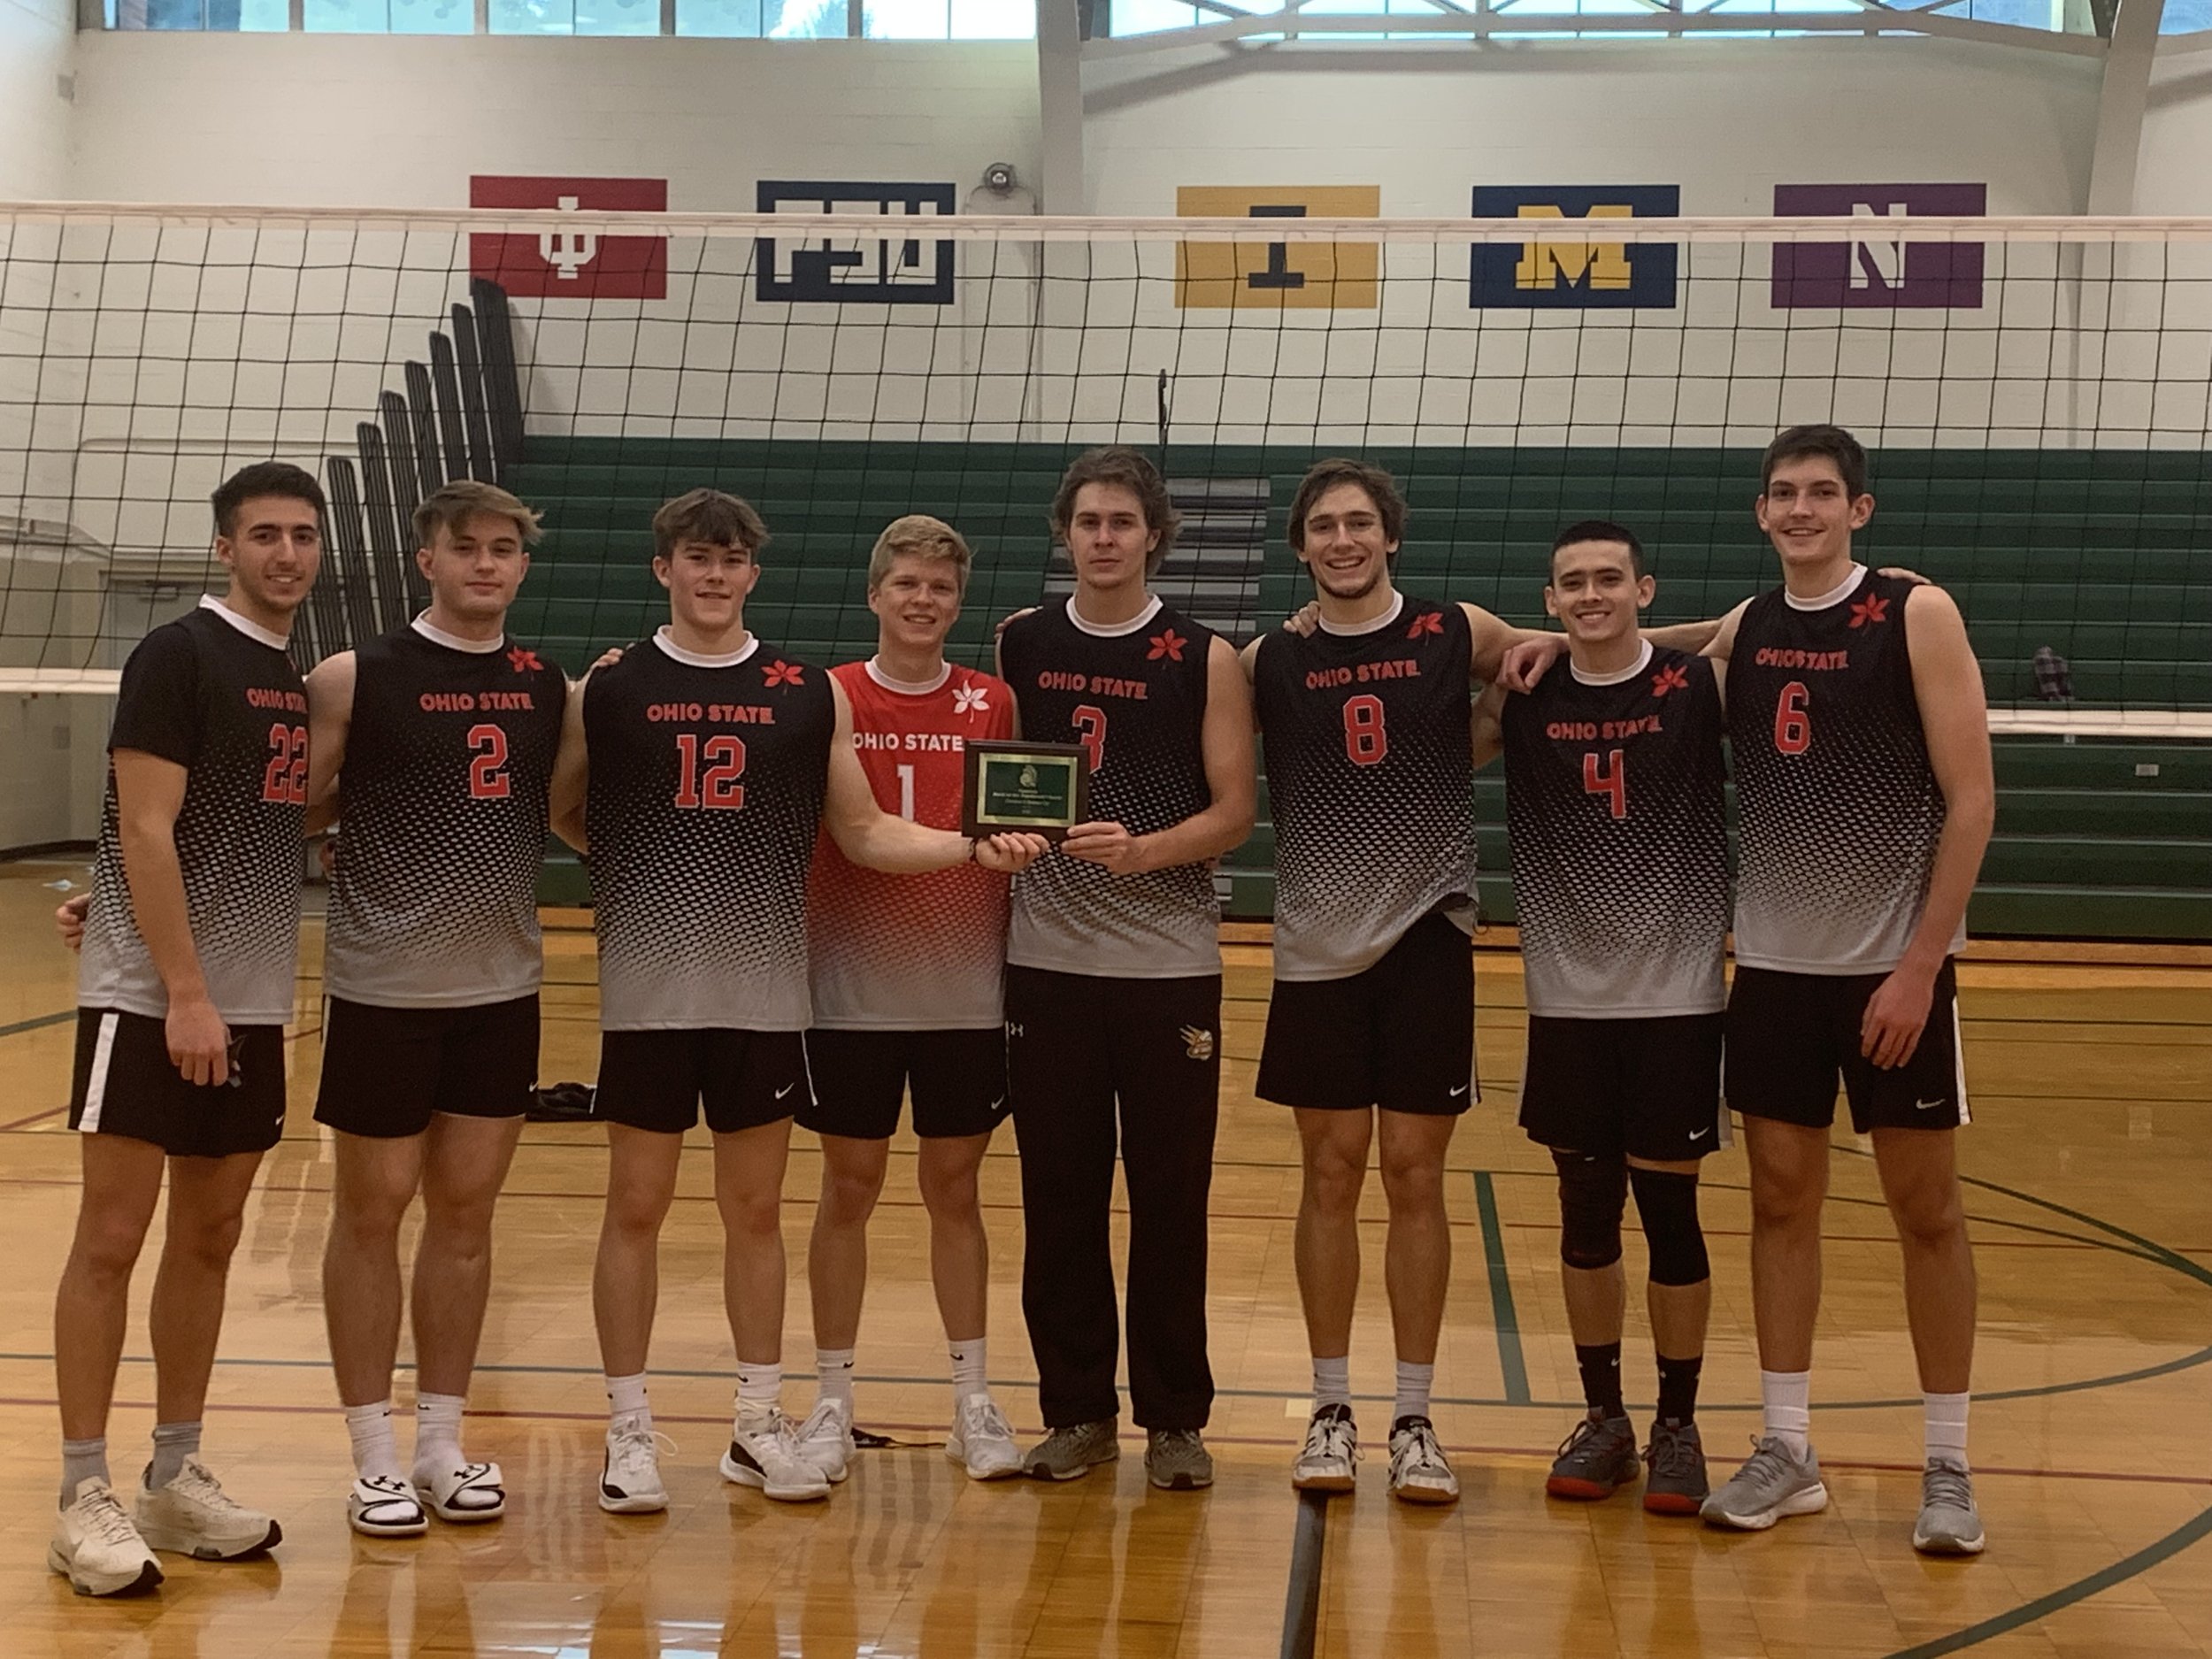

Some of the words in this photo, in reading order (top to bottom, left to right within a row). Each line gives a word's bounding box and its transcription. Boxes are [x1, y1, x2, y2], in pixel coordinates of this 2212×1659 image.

[773, 199, 938, 286] PSU
[1515, 204, 1633, 289] M
[1849, 203, 1908, 288] N
[1038, 671, 1087, 691] OHIO
[1089, 676, 1148, 700] STATE
[1306, 666, 1352, 689] OHIO
[1356, 659, 1422, 682] STATE
[1755, 648, 1795, 667] OHIO
[246, 687, 284, 710] OHIO
[419, 693, 475, 711] OHIO
[479, 692, 535, 710] STATE
[647, 703, 703, 722] OHIO
[708, 704, 775, 725] STATE
[1342, 694, 1388, 766] 8
[1546, 721, 1597, 741] OHIO
[1601, 714, 1663, 741] STATE
[1775, 680, 1810, 755] 6
[263, 723, 308, 804] 22
[467, 724, 511, 799] 2
[675, 733, 746, 810] 12
[853, 732, 900, 749] OHIO
[904, 733, 965, 752] STATE
[1071, 704, 1108, 775] 3
[896, 764, 915, 823] 1
[1583, 749, 1627, 819] 4
